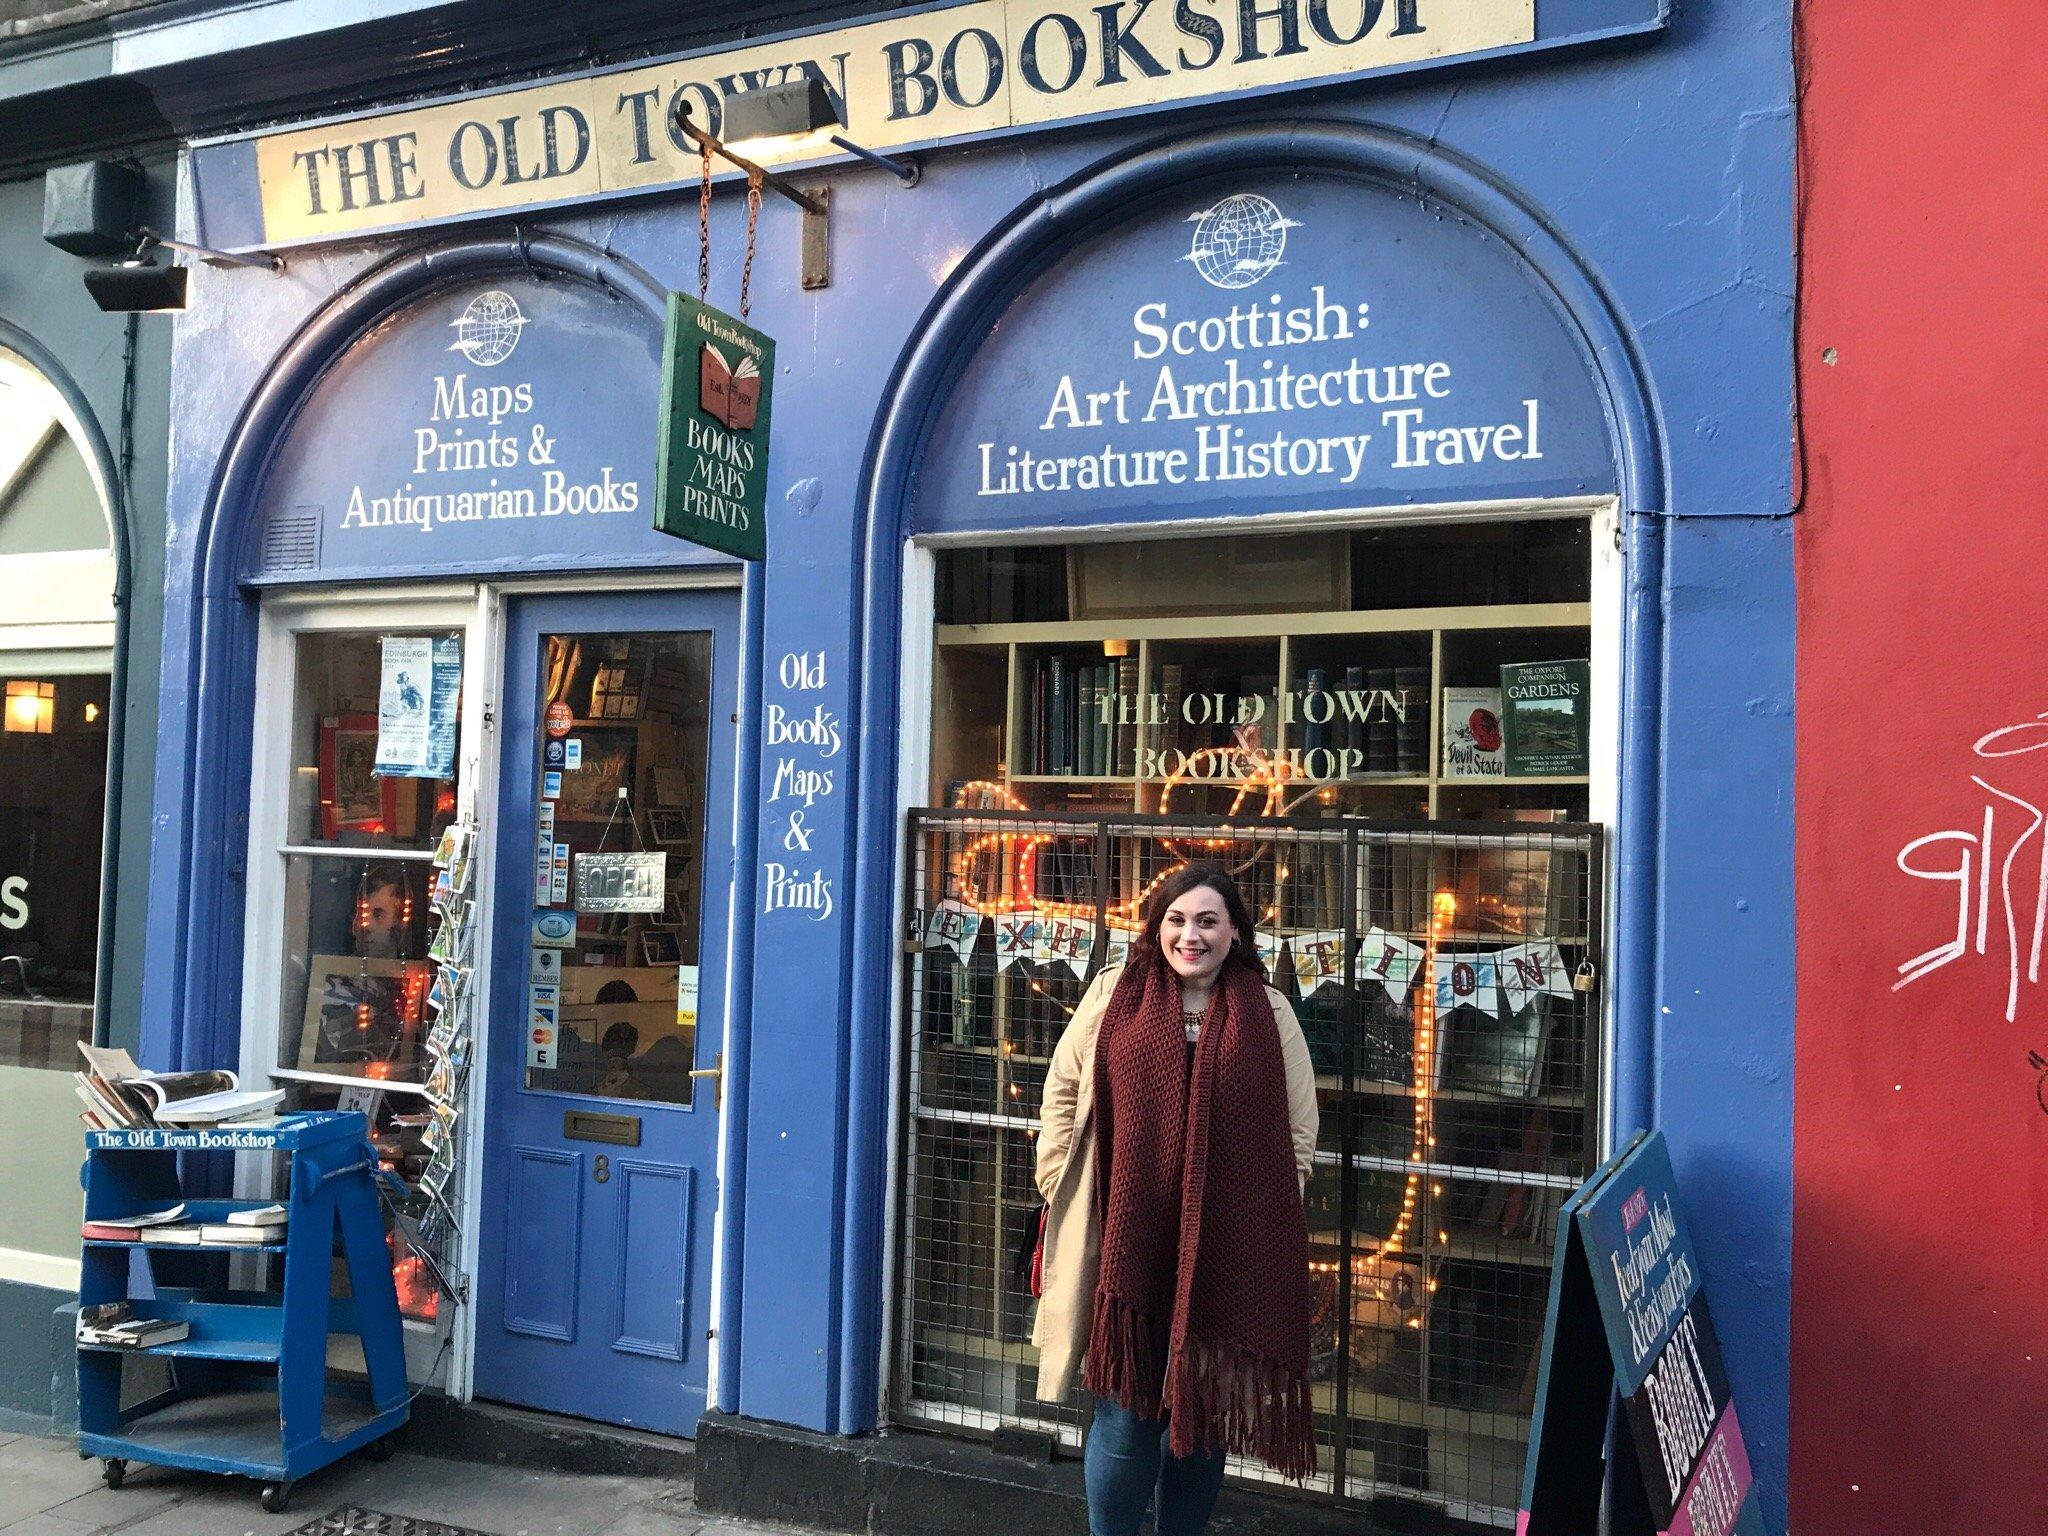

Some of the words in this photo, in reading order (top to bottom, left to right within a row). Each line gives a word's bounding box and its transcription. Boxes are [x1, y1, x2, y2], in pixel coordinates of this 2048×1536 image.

[293, 131, 425, 216] THE
[447, 105, 591, 190] OLD
[696, 312, 711, 333] Old
[1132, 285, 1371, 360] Scottish:
[430, 374, 534, 425] Maps
[1039, 375, 1130, 430] Art
[1140, 359, 1451, 424] Architecture
[413, 428, 519, 474] Prints
[528, 423, 557, 466] &
[686, 417, 754, 472] BOOKS
[977, 442, 1189, 496] Literature
[1194, 423, 1371, 484] History
[1381, 399, 1543, 468] Travel
[340, 478, 537, 533] Antiquarian
[541, 467, 639, 516] Books
[688, 455, 746, 500] MAPS
[683, 485, 750, 531] PRINTS
[384, 650, 428, 658] EDINBURGH
[779, 650, 827, 691] Old
[1535, 666, 1565, 674] OXFORD
[1508, 683, 1580, 699] GARDENS
[1518, 672, 1566, 684] COMPANION
[1095, 692, 1169, 725] THE
[1182, 691, 1266, 726] OLD
[1273, 687, 1410, 724] TOWN
[767, 703, 841, 758] Books
[1449, 742, 1472, 763] Devil
[767, 757, 833, 808] Maps
[1133, 746, 1363, 781] BOOKSHOP
[1474, 754, 1502, 775] State
[784, 810, 815, 851] &
[589, 867, 651, 898] OPEN
[763, 862, 832, 922] Prints
[533, 974, 558, 983] MEMBER
[95, 1133, 123, 1148] The
[128, 1131, 155, 1148] Old
[161, 1132, 197, 1148] Town
[198, 1131, 276, 1149] Bookshop
[1648, 1192, 1676, 1255] Mind
[1644, 1308, 1716, 1506] BOOKS
